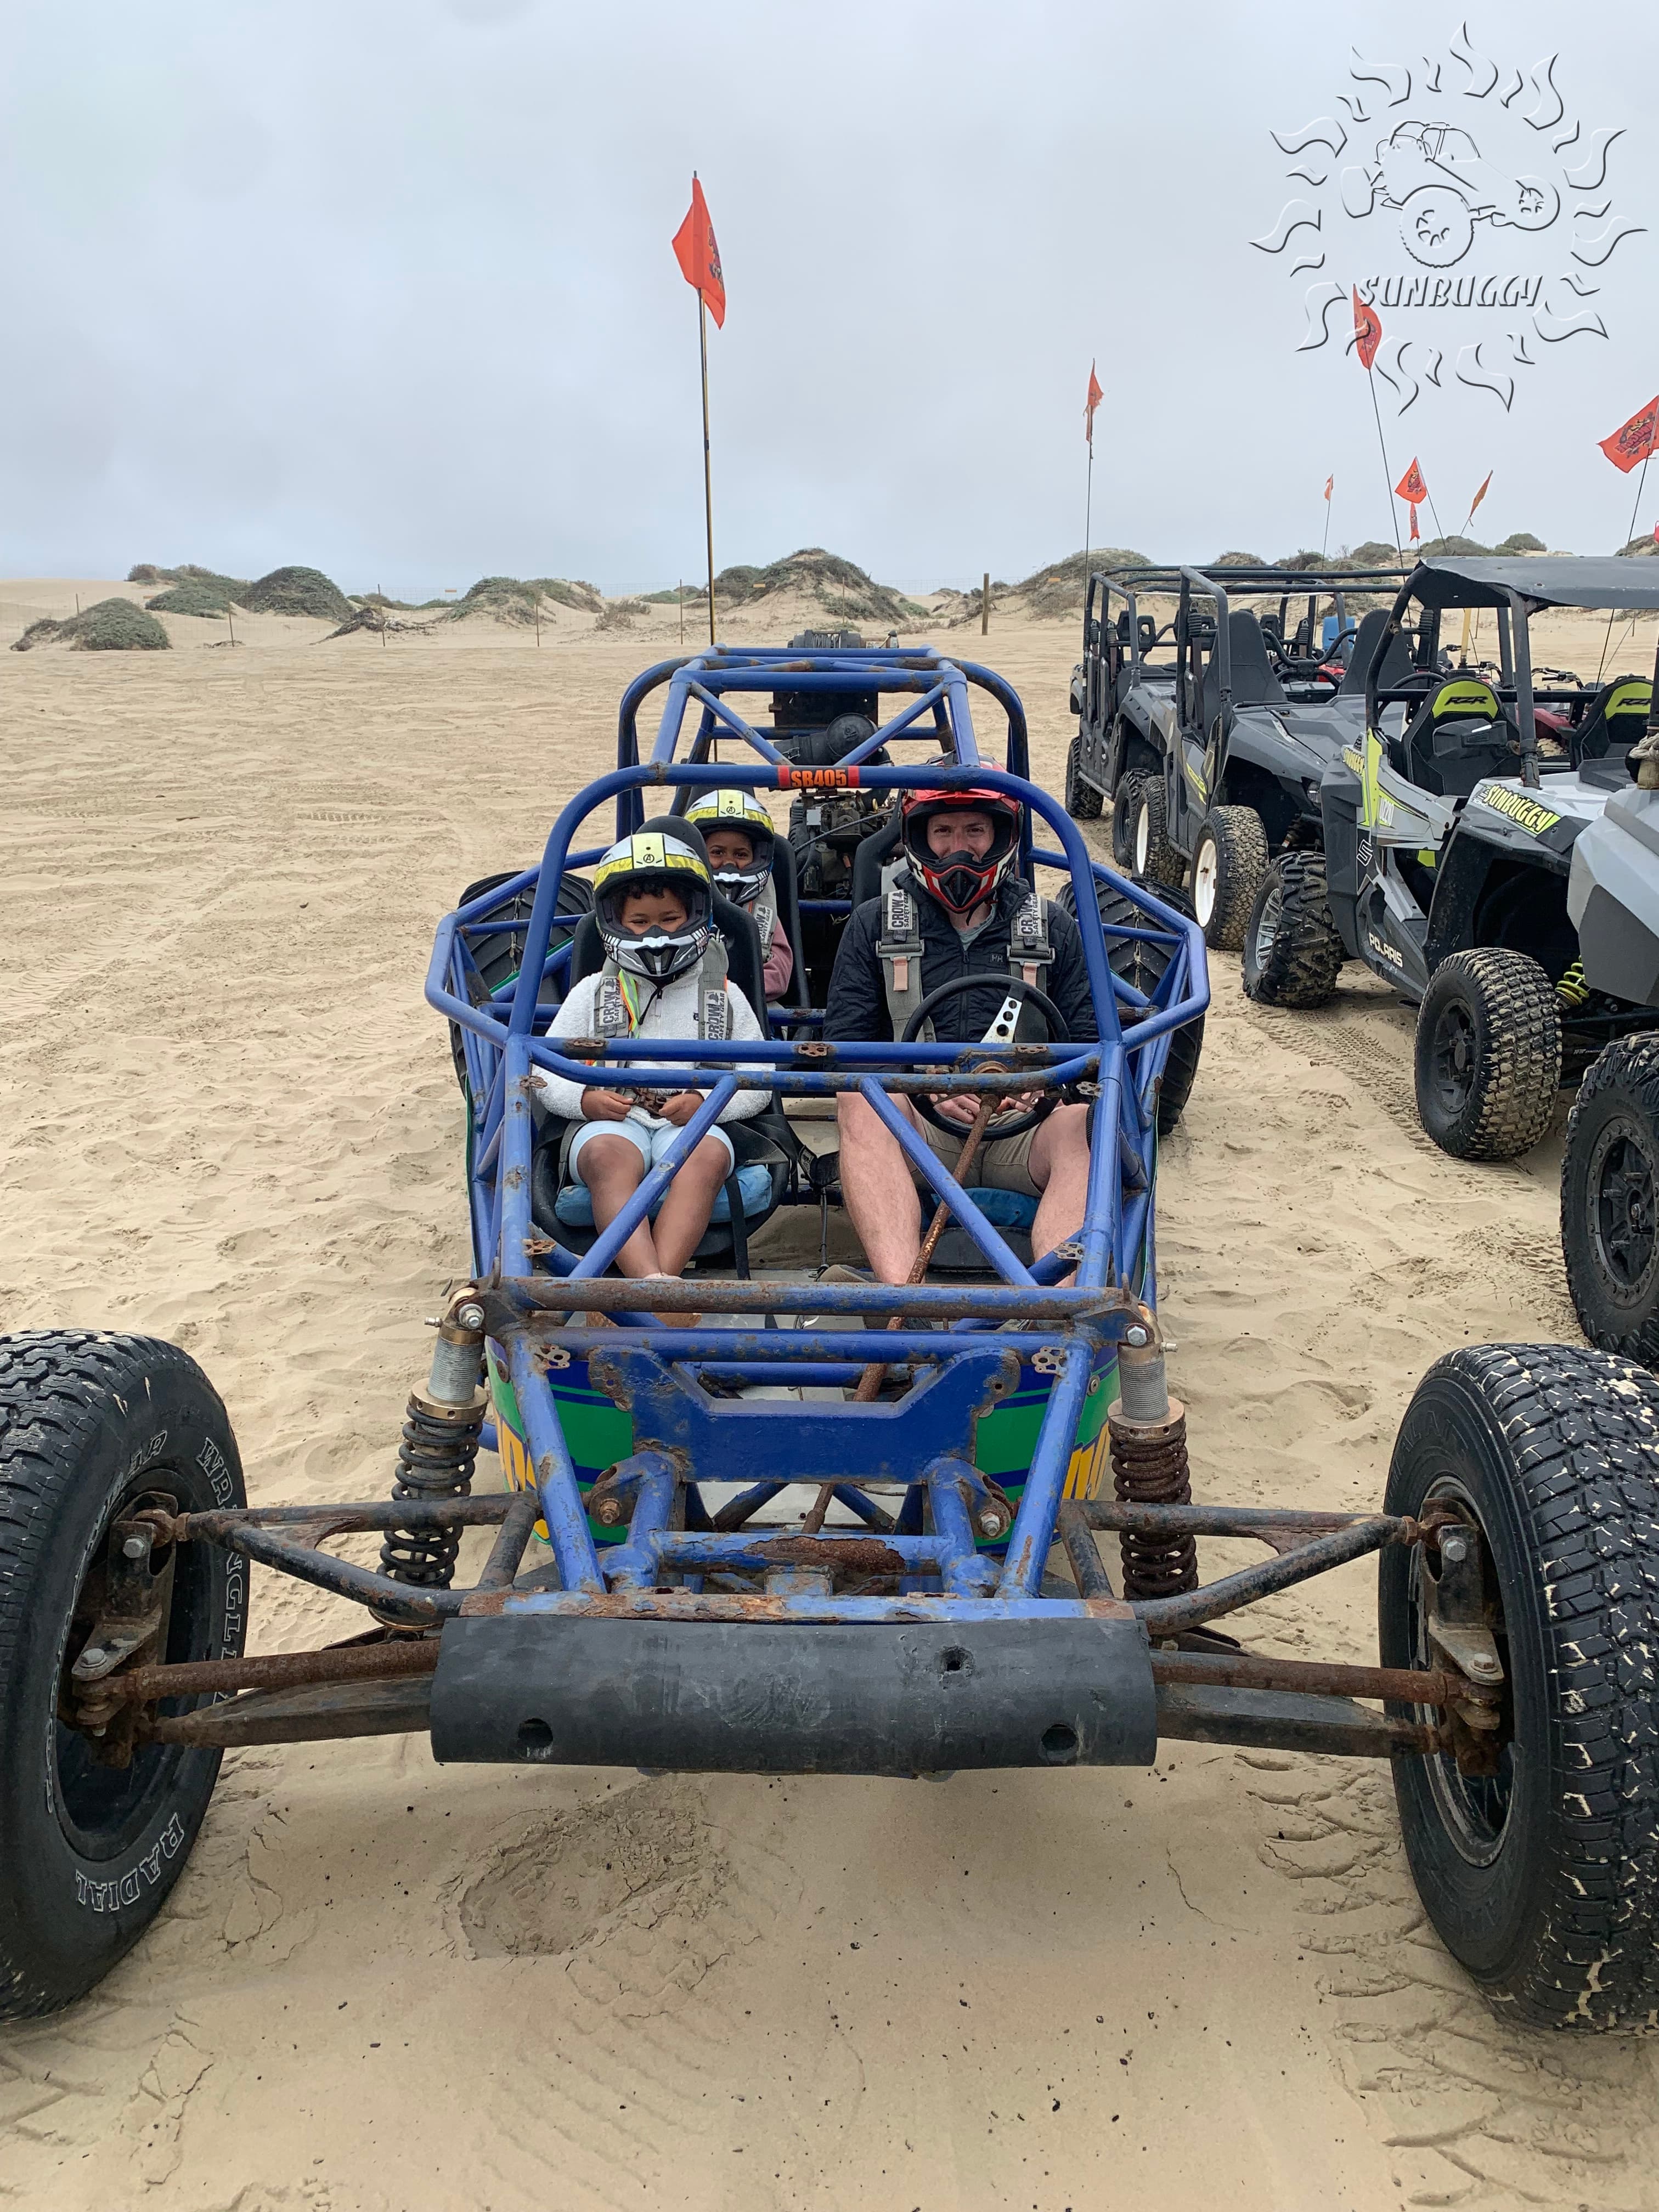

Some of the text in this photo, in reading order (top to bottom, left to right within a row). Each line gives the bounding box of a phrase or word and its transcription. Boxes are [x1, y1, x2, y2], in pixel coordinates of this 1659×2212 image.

[1444, 696, 1488, 706] RZR
[791, 769, 847, 788] SB405
[1482, 783, 1555, 832] SUNBUGGY
[891, 898, 904, 928] CROW
[1020, 904, 1034, 935] CROW
[602, 991, 616, 1024] CROW
[708, 1005, 720, 1040] CROW
[75, 1812, 185, 1913] RADIAL
